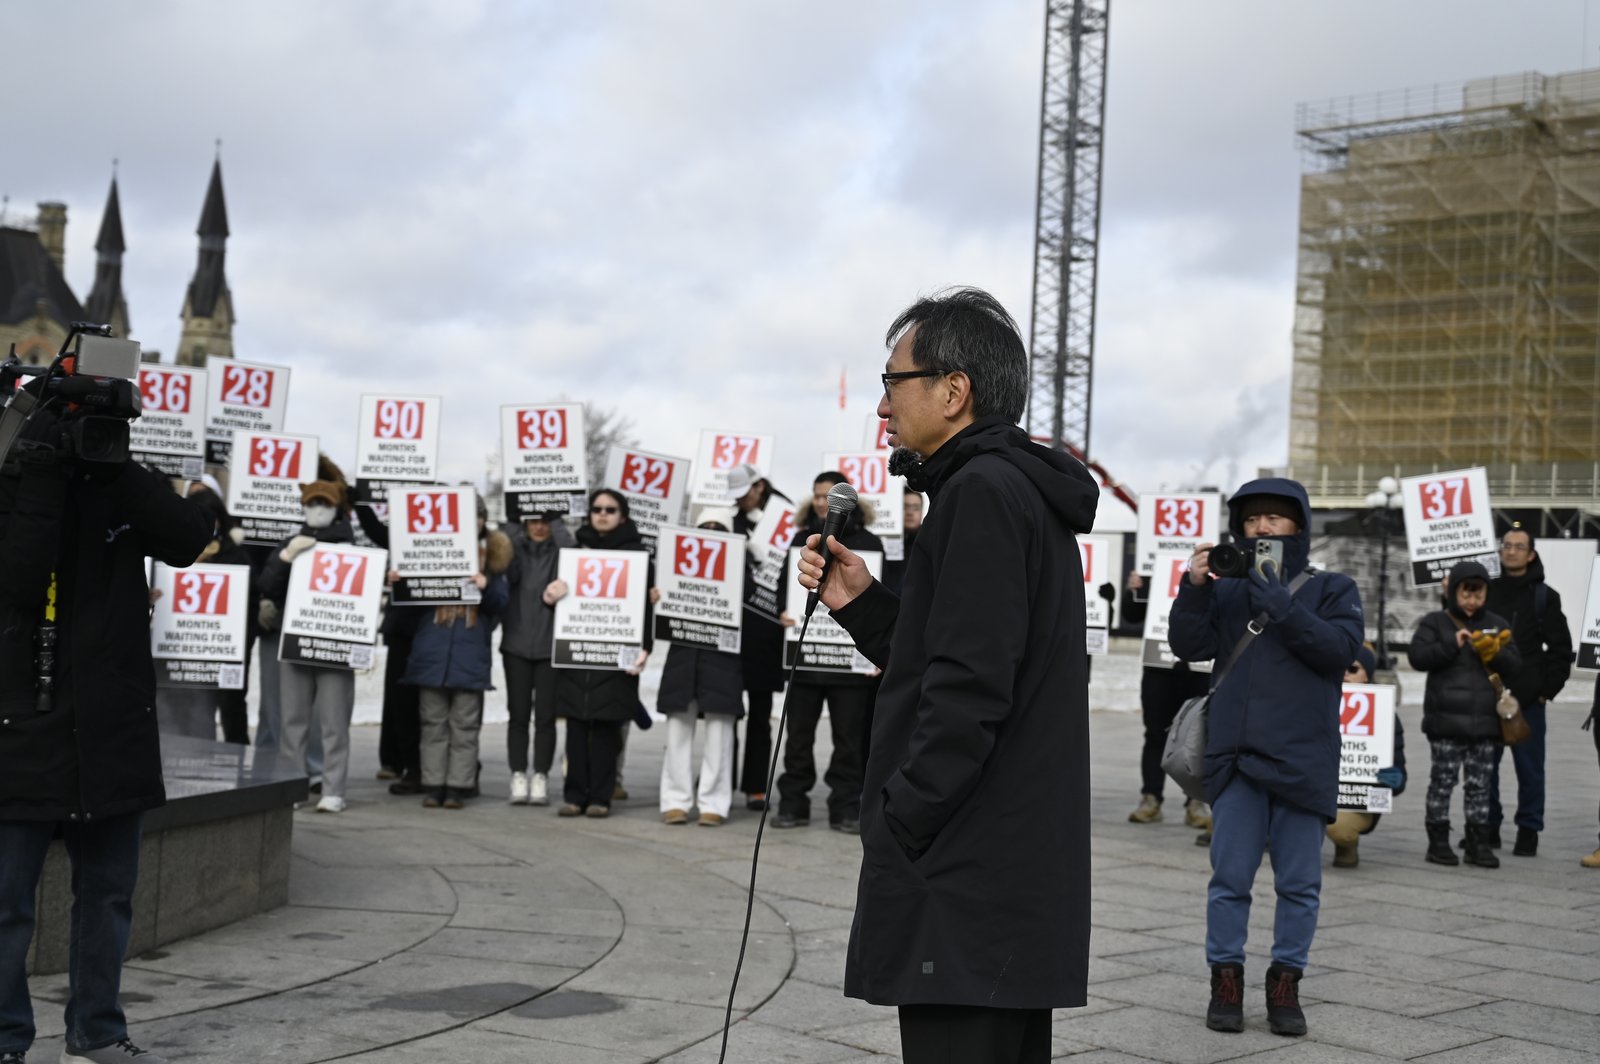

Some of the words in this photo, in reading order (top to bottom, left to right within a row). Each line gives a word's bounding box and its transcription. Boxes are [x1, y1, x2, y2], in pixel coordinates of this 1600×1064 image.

[143, 372, 186, 412] 36
[225, 368, 268, 406] 28
[224, 408, 262, 419] MONTHS
[142, 416, 183, 426] MONTHS
[212, 418, 251, 428] WAITING
[378, 401, 419, 438] 90
[174, 430, 192, 438] FOR
[522, 410, 562, 448] 39
[146, 440, 198, 450] RESPONSE
[378, 444, 416, 452] MONTHS
[524, 454, 563, 462] MONTHS
[717, 437, 754, 468] 37
[254, 440, 296, 478] 37
[368, 454, 406, 463] WAITING
[408, 456, 426, 464] FOR
[382, 466, 430, 475] RESPONSE
[626, 456, 668, 496] 32
[844, 457, 883, 494] 30
[532, 476, 579, 486] RESPONSE
[252, 482, 292, 492] MONTHS
[241, 492, 280, 502] WAITING
[1425, 479, 1464, 518] 37
[256, 504, 304, 515] RESPONS
[413, 494, 454, 532] 31
[1158, 500, 1199, 536] 33
[1429, 520, 1469, 531] MONTHS
[1420, 533, 1460, 544] WAITING
[1463, 530, 1482, 538] FOR
[412, 538, 454, 548] MONTHS
[1438, 540, 1488, 552] RESPONSE
[403, 550, 443, 559] WAITING
[446, 550, 465, 558] FOR
[680, 537, 722, 579] 37
[420, 562, 470, 571] RESPONSE
[315, 554, 362, 596] 37
[581, 559, 623, 598] 37
[178, 574, 224, 614] 37
[678, 582, 719, 595] MONTHS
[312, 598, 356, 610] MONTHS
[668, 591, 708, 606] WAITING
[710, 598, 729, 608] FOR
[580, 602, 620, 612] MONTHS
[299, 608, 342, 621] WAITING
[345, 613, 365, 624] FOR
[684, 606, 733, 620] RESPONSE
[569, 614, 609, 623] WAITING
[612, 615, 631, 624] FOR
[177, 620, 221, 630] MONTHS
[291, 618, 314, 630] IRCC
[315, 621, 369, 637] RESPONSE
[164, 631, 208, 642] WAITING
[212, 633, 232, 642] FOR
[585, 626, 635, 638] RESPONSE
[298, 637, 312, 648] NO
[800, 642, 814, 654] NO
[182, 644, 237, 656] RESPONSE
[300, 648, 314, 658] NO
[804, 654, 818, 664] NO
[166, 661, 180, 670] NO
[170, 672, 182, 681] NO
[1358, 754, 1378, 764] FOR
